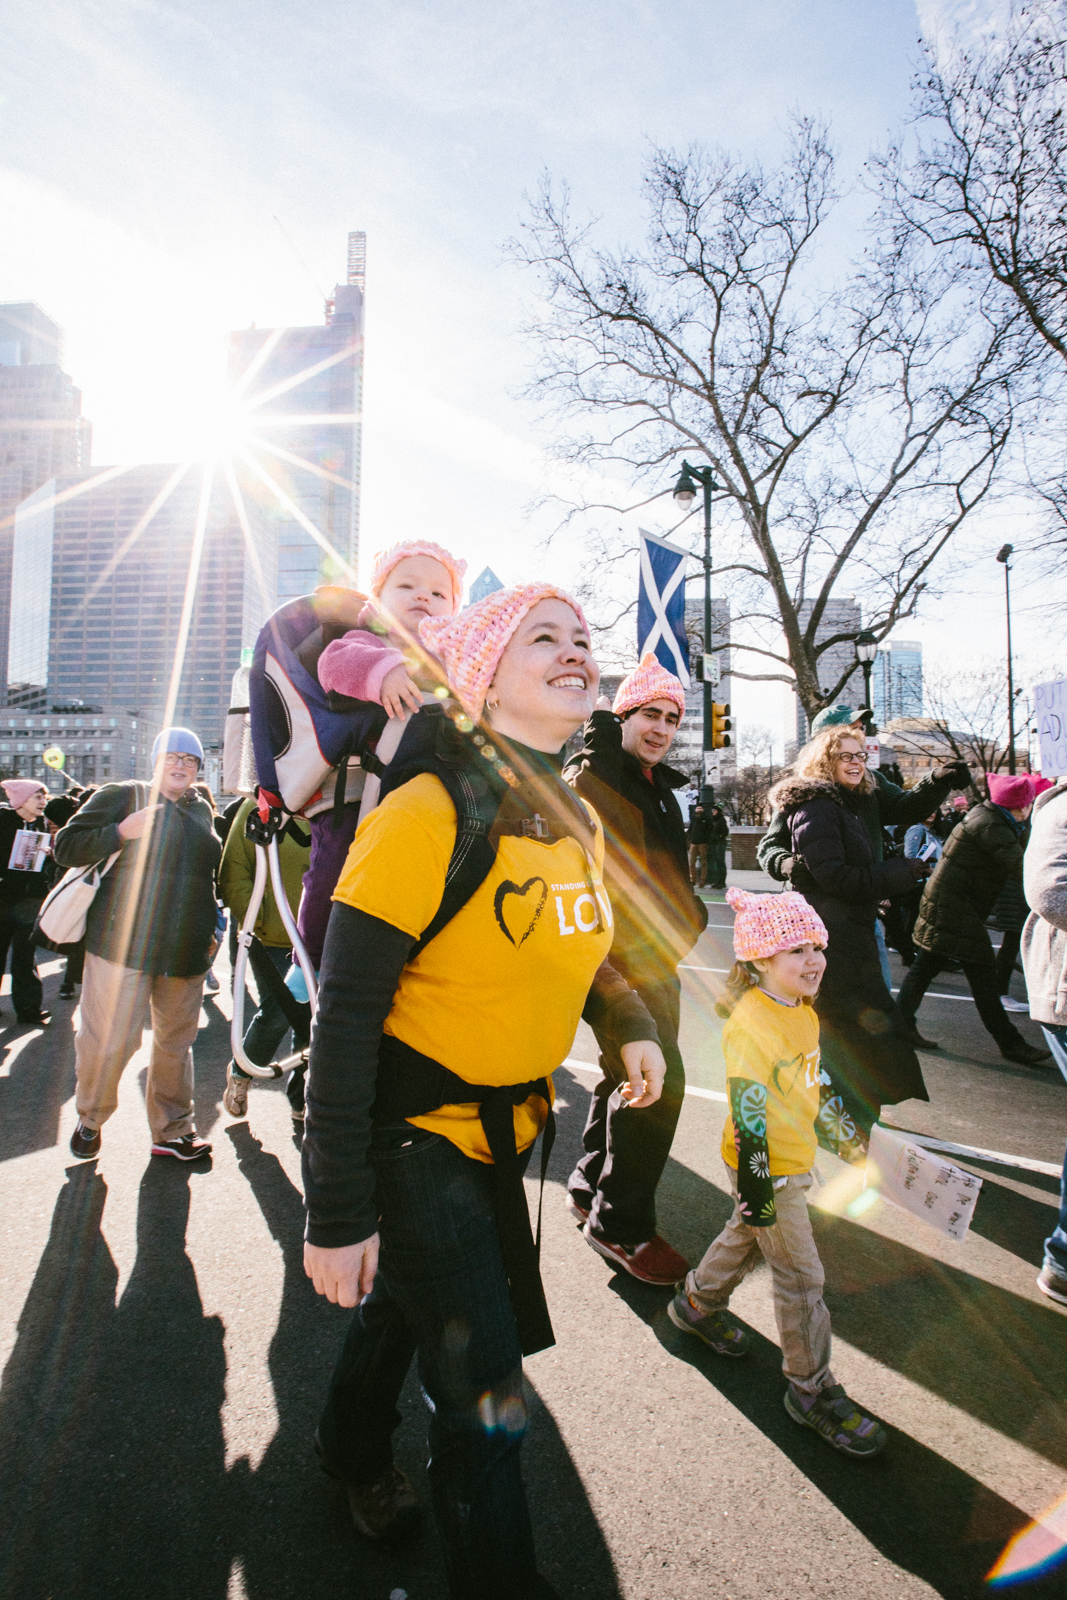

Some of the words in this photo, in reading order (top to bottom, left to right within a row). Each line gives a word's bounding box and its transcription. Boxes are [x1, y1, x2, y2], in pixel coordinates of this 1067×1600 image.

[1035, 681, 1065, 711] PUT
[1056, 744, 1067, 770] C
[551, 882, 586, 891] STANDING
